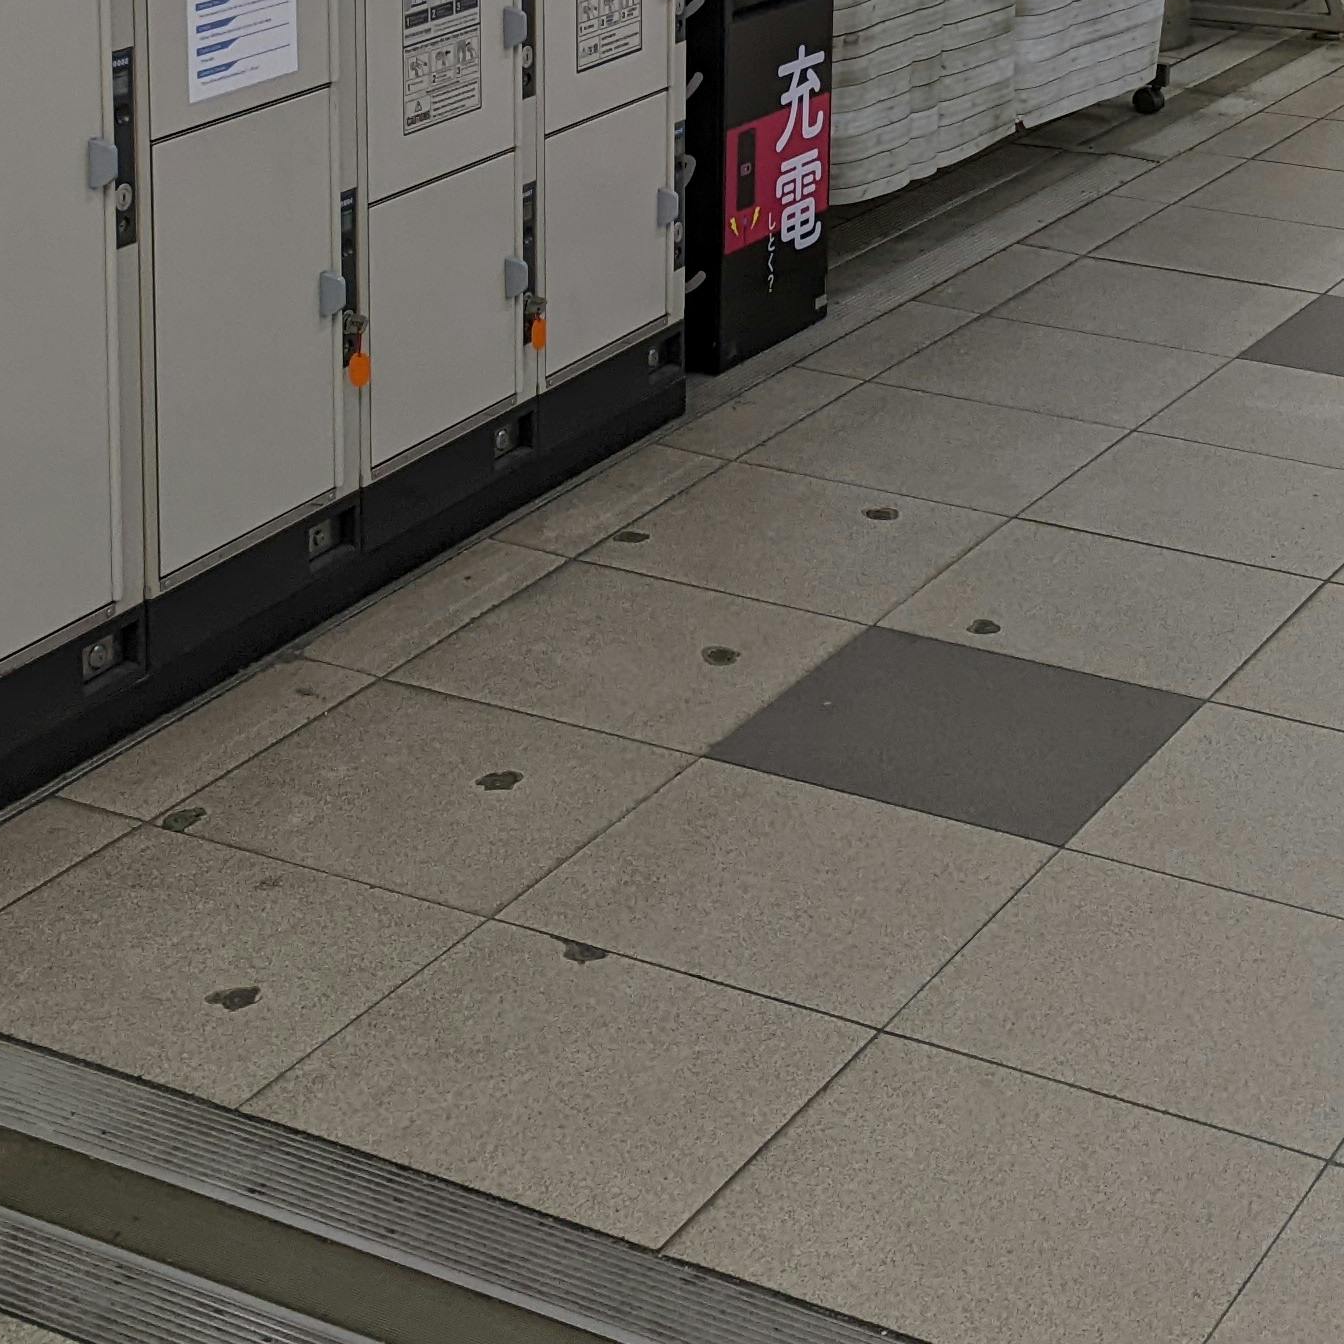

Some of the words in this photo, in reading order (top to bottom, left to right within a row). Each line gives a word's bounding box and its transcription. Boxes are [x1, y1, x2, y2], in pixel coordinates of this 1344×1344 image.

[775, 44, 825, 251] 充電
[767, 211, 776, 294] しとく?
